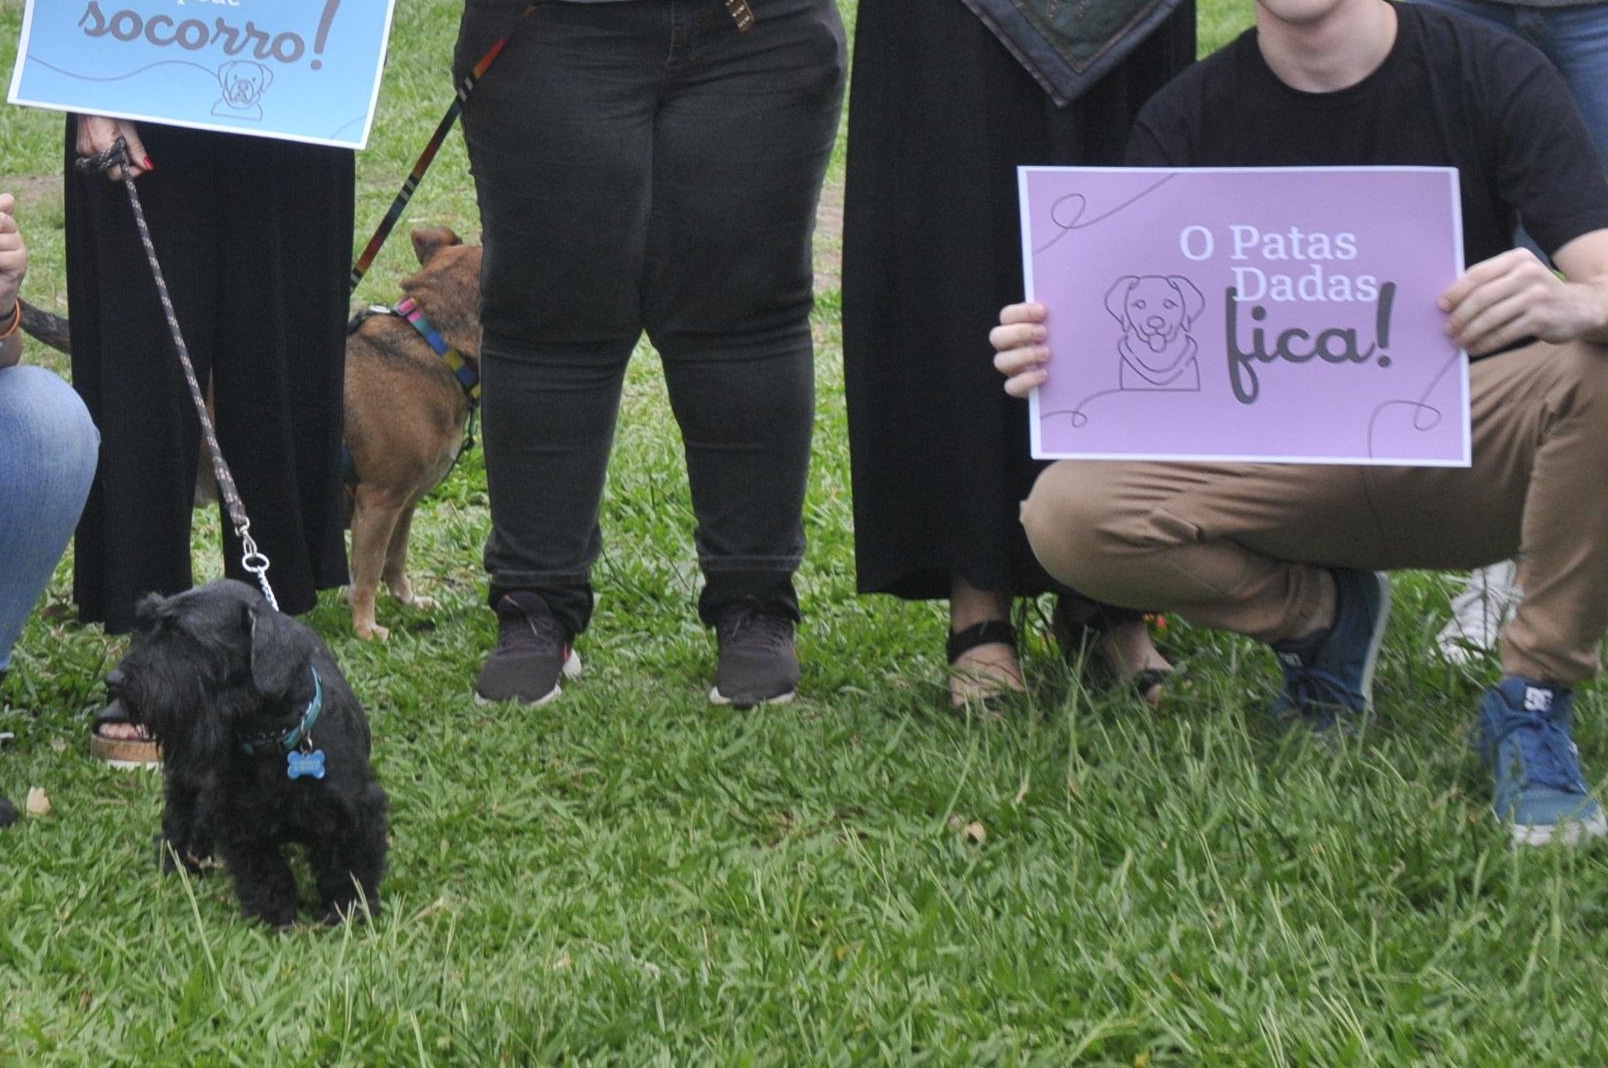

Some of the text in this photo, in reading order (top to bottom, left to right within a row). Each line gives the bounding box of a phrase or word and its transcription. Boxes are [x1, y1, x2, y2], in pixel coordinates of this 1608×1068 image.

[1180, 225, 1358, 261] O Patas
[1230, 263, 1378, 302] Dadas
[1225, 281, 1397, 404] fica!
